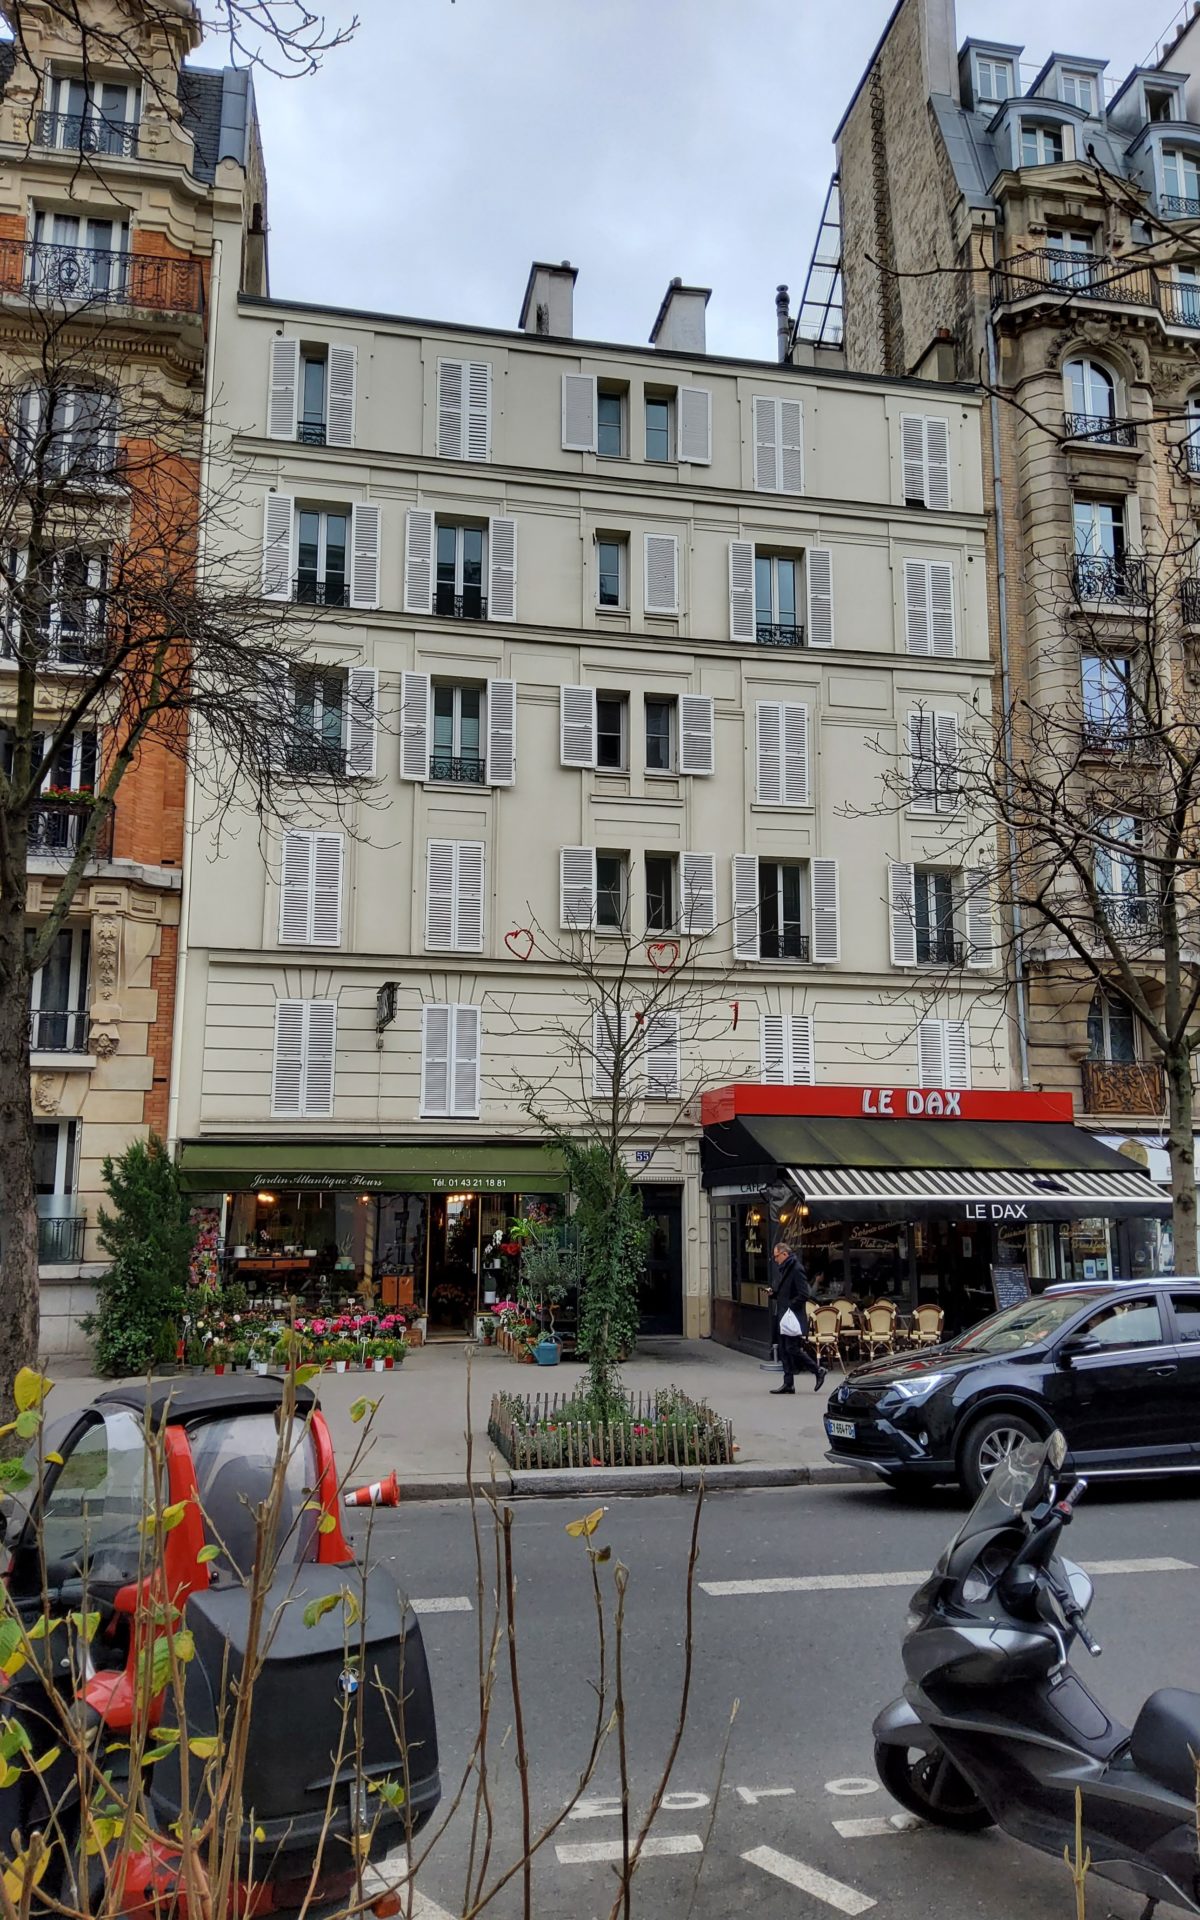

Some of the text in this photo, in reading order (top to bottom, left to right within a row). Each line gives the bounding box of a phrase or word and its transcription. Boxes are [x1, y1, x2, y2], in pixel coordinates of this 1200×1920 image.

[862, 1089, 961, 1116] LE DAX
[637, 1151, 649, 1161] 55
[250, 1174, 383, 1188] Jardin Atlantique Fleurs
[432, 1178, 506, 1187] Tél. 01 43 21 18 81
[965, 1203, 1028, 1220] LE DAX
